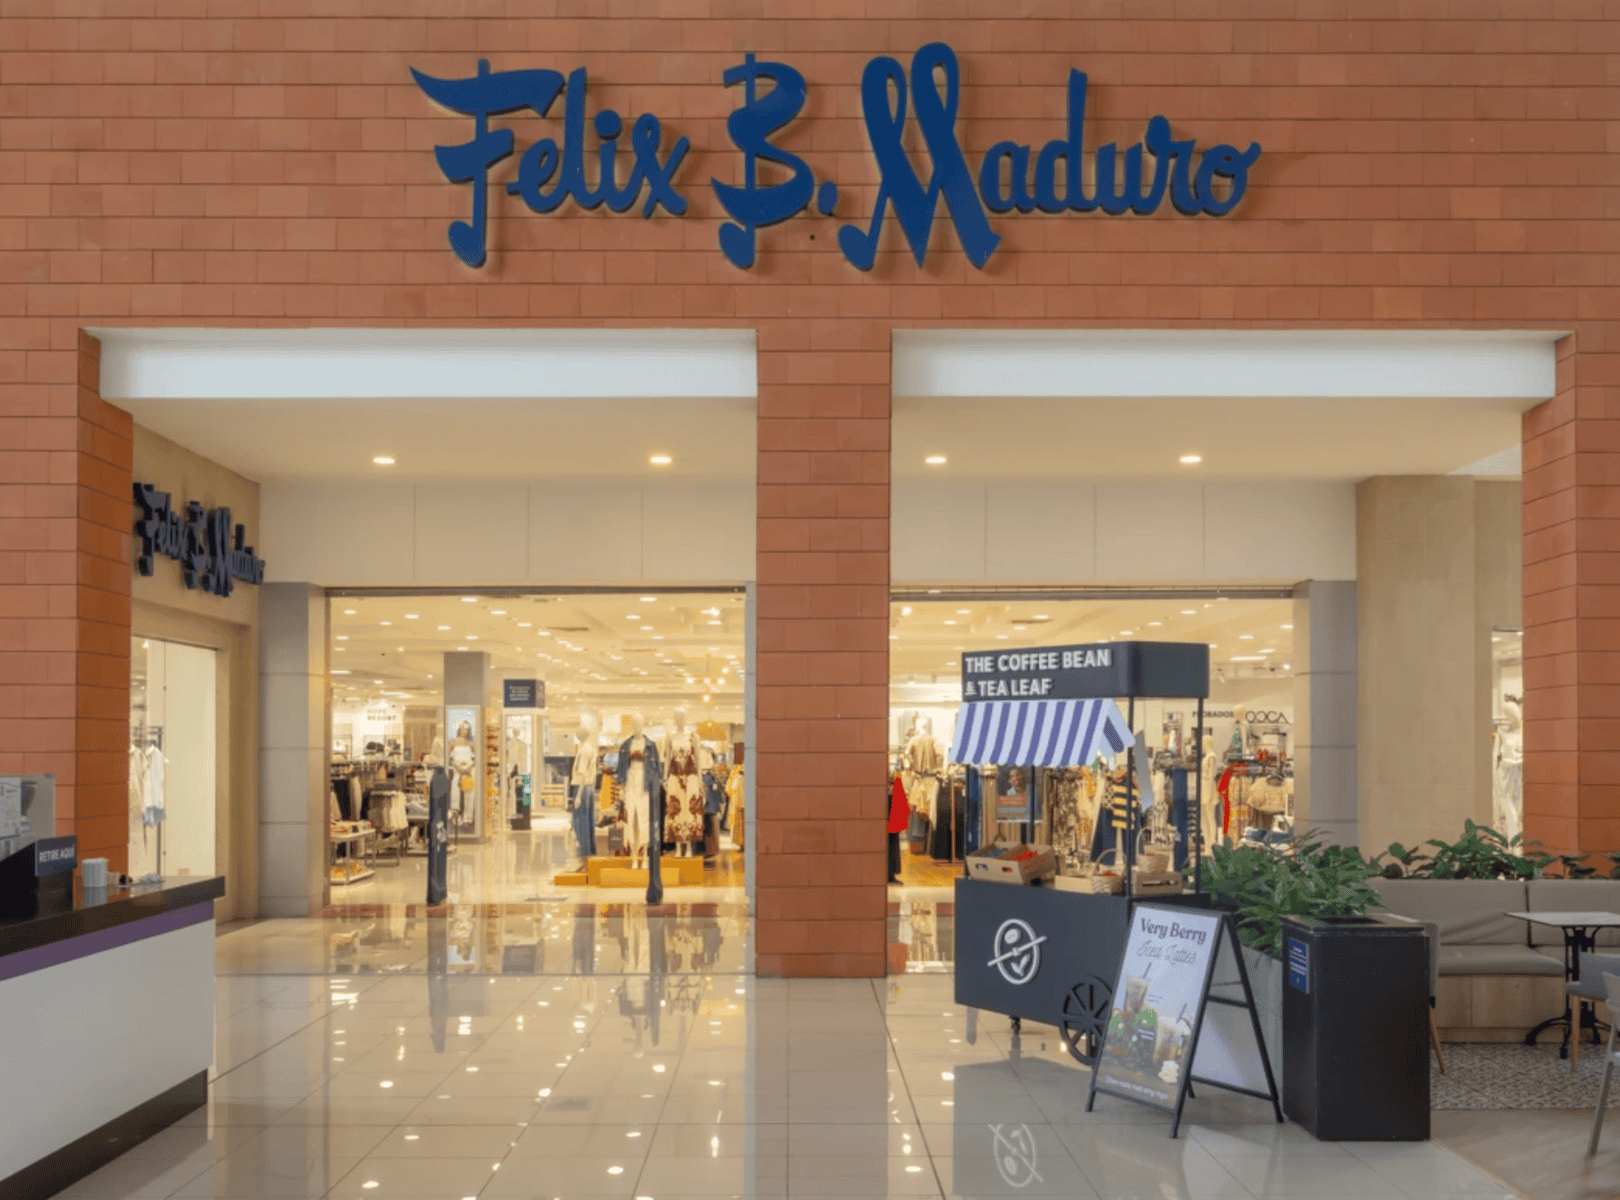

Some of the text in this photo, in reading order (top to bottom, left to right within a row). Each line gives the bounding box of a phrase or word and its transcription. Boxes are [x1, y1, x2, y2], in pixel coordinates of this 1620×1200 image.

[411, 42, 1261, 270] Felix B. Maduro
[133, 482, 187, 577] Felix
[201, 506, 265, 597] Maduro
[965, 649, 1112, 673] THE COFFEE BEAN
[965, 678, 1053, 697] & TEA LEAF
[39, 849, 59, 863] RETIRE
[1141, 917, 1207, 945] Very Berry
